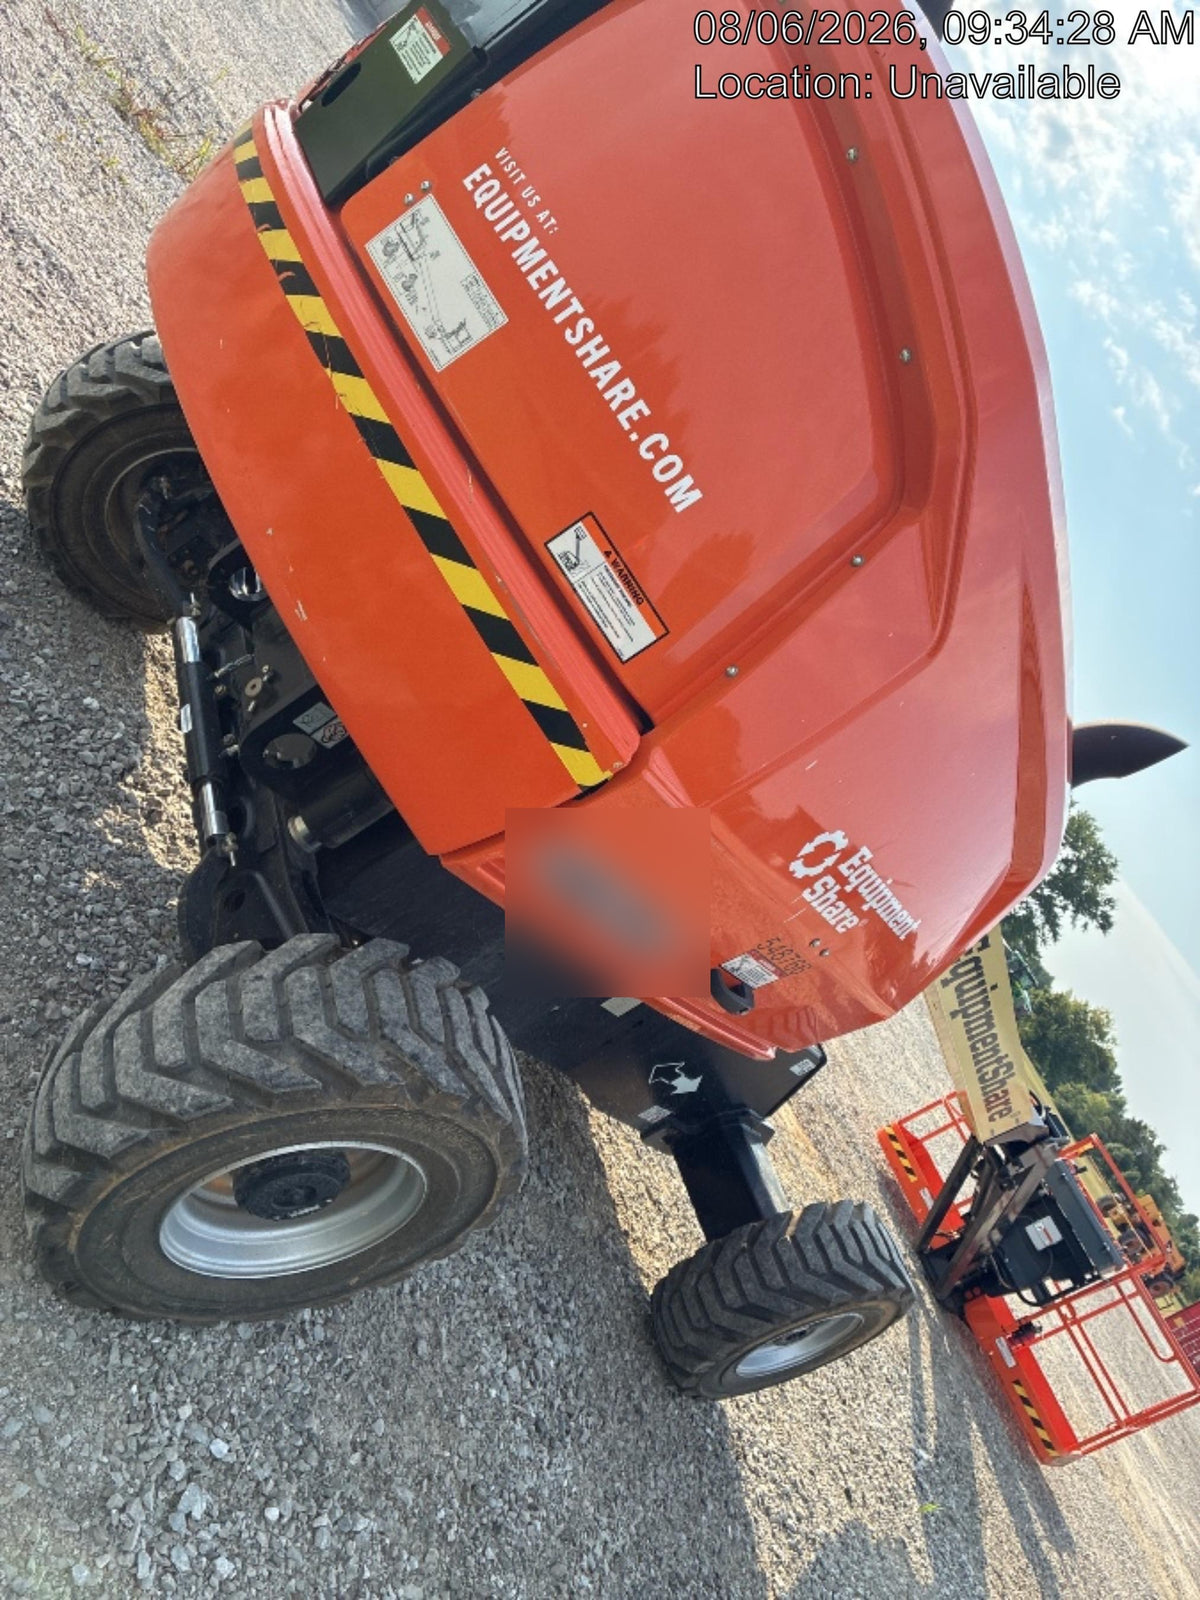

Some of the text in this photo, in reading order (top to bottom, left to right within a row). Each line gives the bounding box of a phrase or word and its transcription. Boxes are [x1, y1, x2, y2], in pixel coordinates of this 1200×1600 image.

[495, 147, 559, 235] VISIT US AT:
[462, 163, 703, 514] EQUIPMENTSHARE.COM
[802, 874, 860, 934] Share
[837, 845, 921, 940] Equipment
